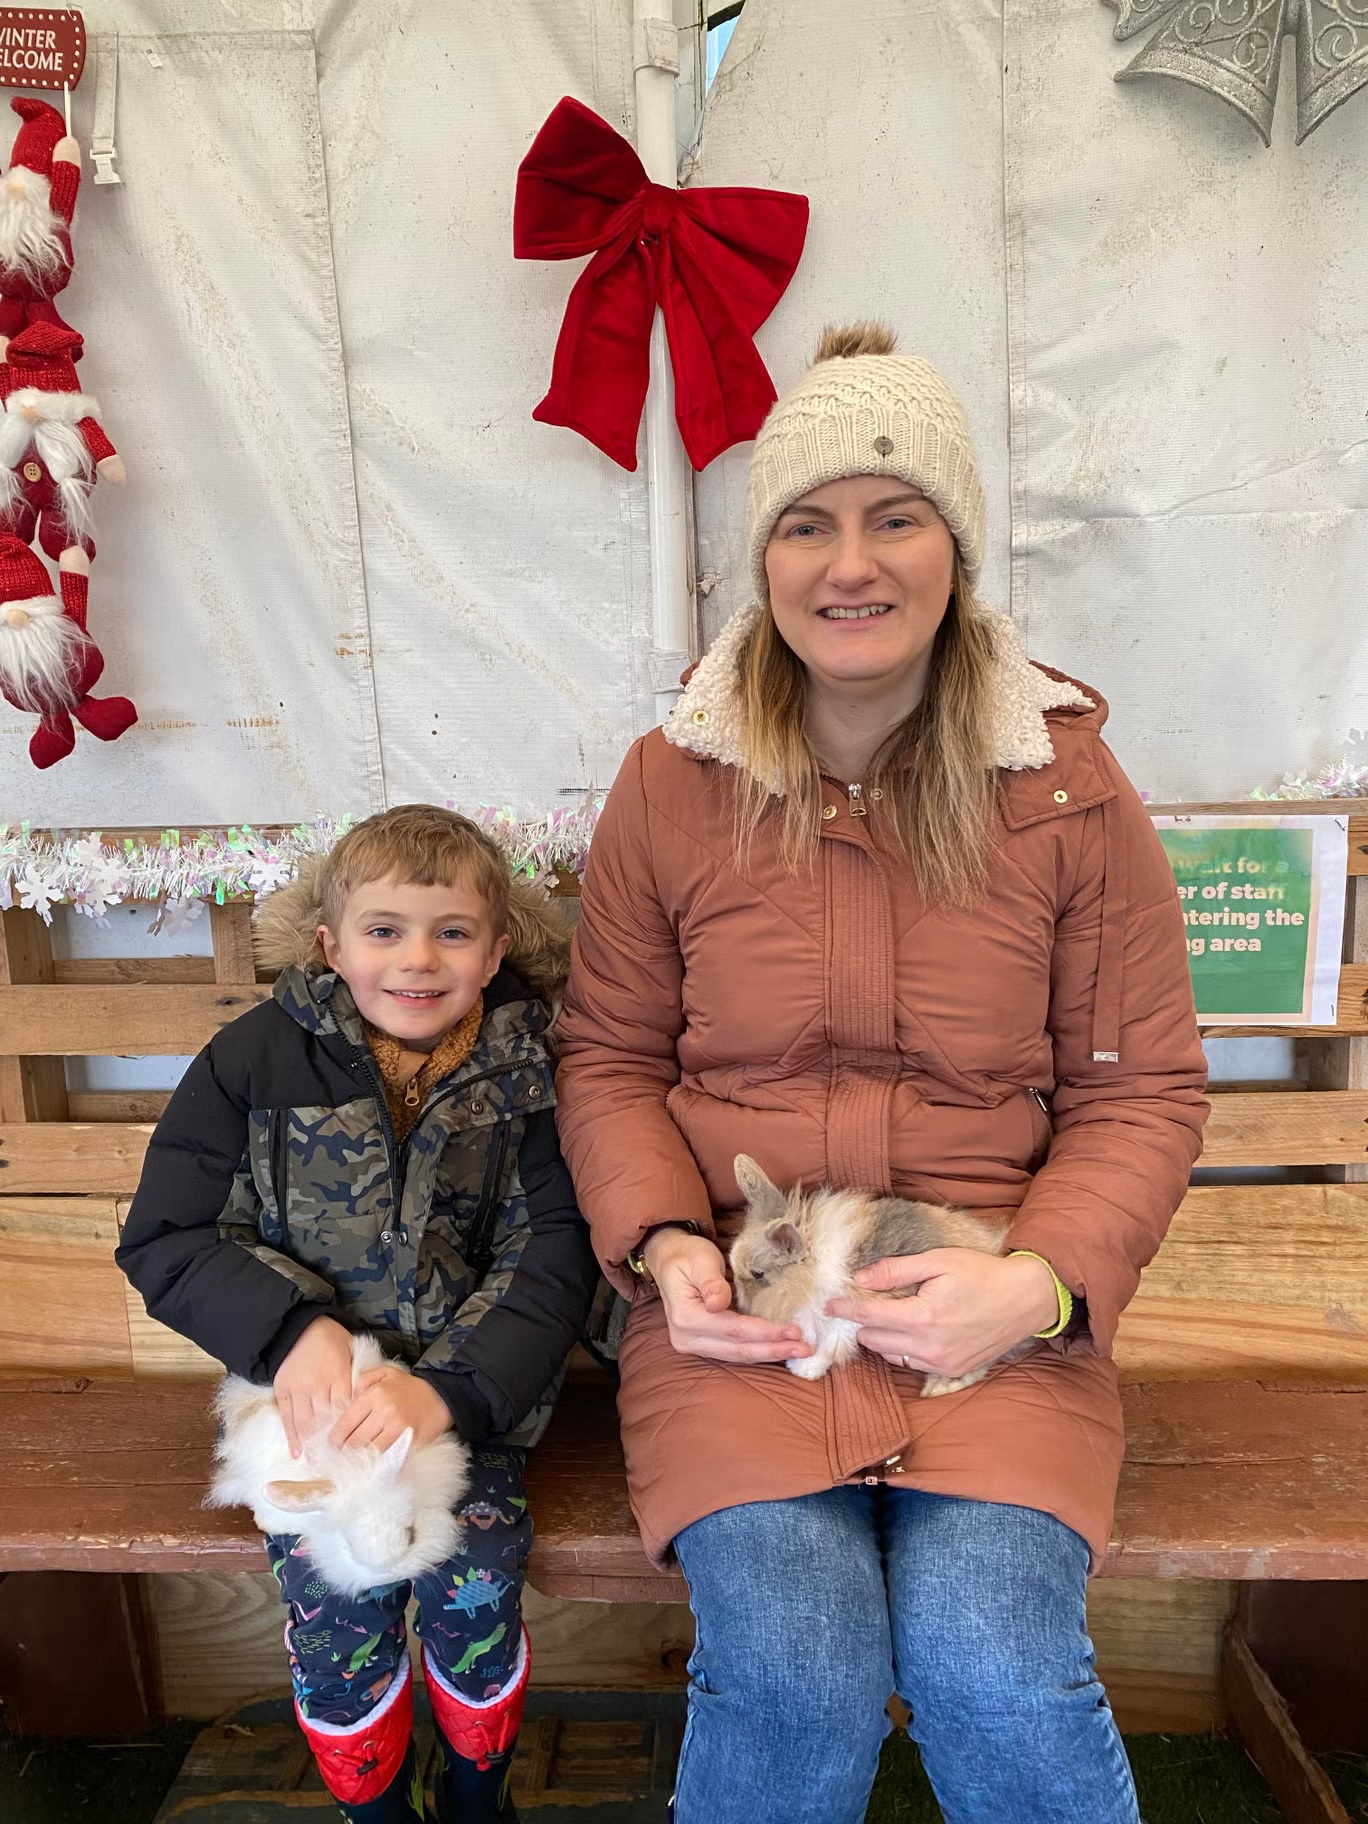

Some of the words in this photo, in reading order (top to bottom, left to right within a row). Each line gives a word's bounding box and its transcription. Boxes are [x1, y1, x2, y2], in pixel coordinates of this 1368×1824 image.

[1237, 857, 1271, 874] for
[1276, 860, 1289, 874] a
[1201, 882, 1228, 900] of
[1231, 882, 1287, 900] staff
[1265, 908, 1305, 926] the
[1209, 938, 1262, 952] area
